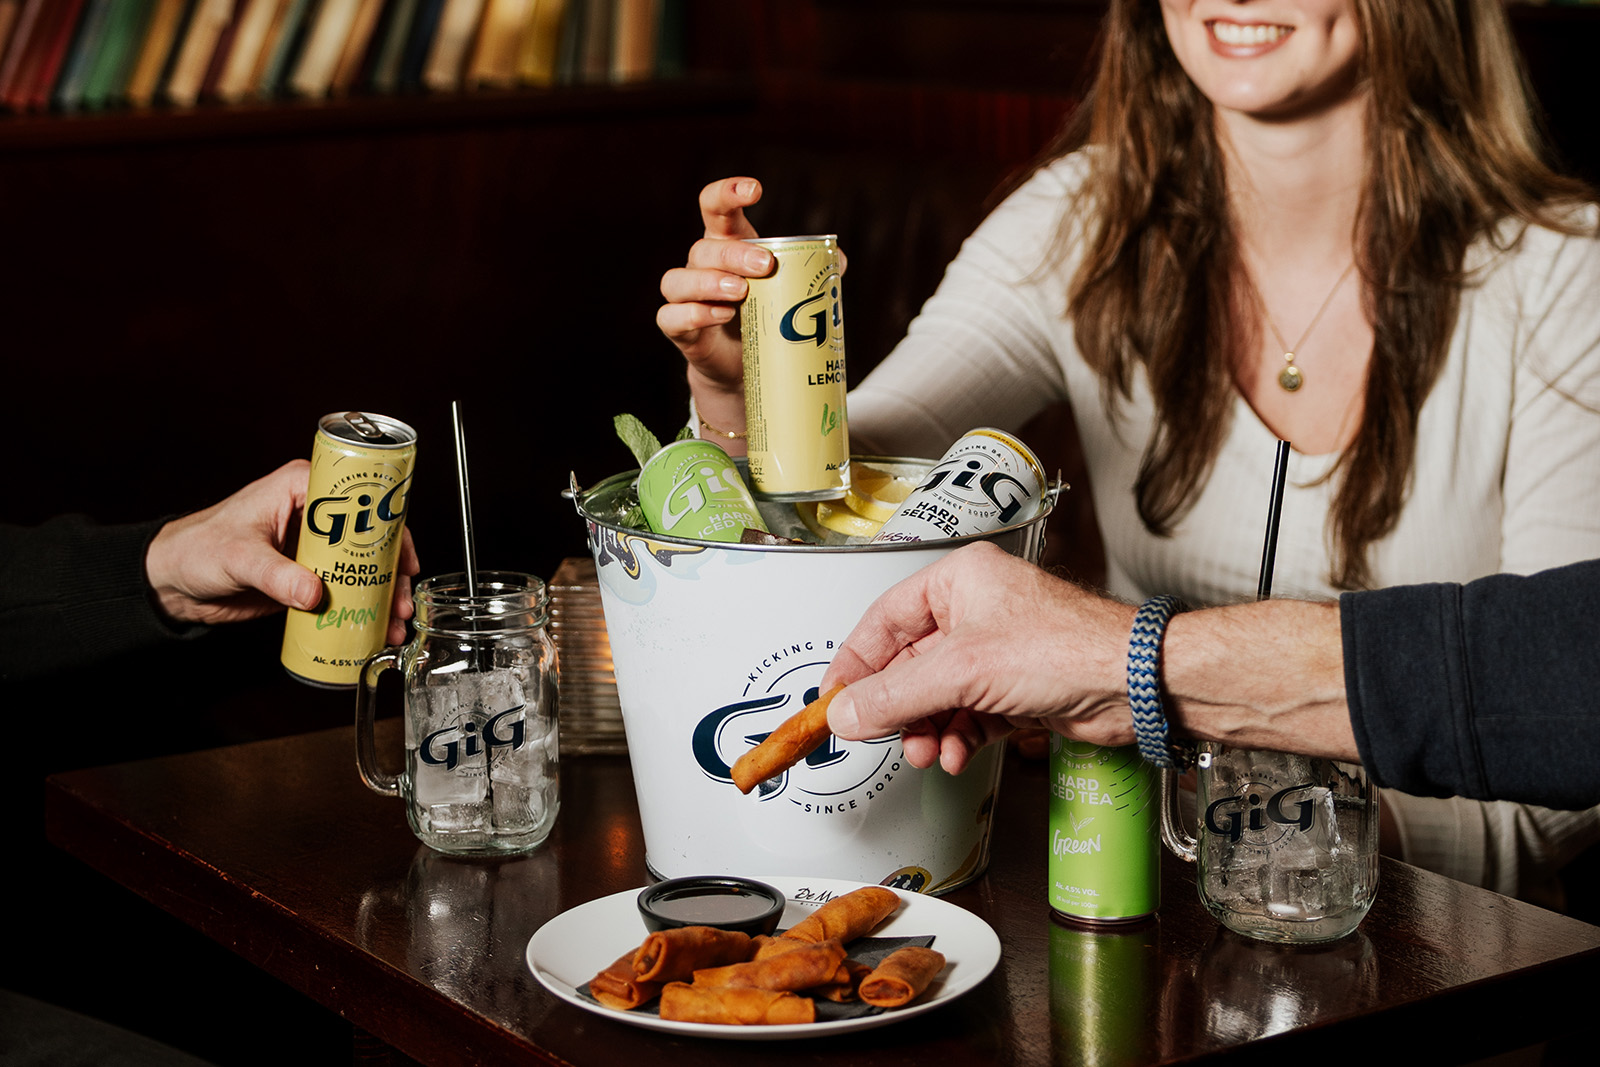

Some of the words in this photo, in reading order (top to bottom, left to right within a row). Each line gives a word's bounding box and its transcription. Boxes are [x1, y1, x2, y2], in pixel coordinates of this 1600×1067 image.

[779, 286, 842, 348] Gi
[826, 359, 845, 371] HAR
[708, 511, 754, 524] HARD
[916, 501, 960, 526] HARD
[698, 519, 736, 539] ICED
[350, 550, 376, 558] SINCE
[334, 561, 378, 575] HARD
[747, 640, 814, 683] KICKING
[419, 704, 527, 772] GiG
[804, 799, 858, 814] SINCE
[866, 761, 901, 800] 2020
[1057, 772, 1099, 791] HARD
[1051, 783, 1076, 801] CED
[1078, 790, 1114, 806] TEA
[1205, 782, 1316, 843] GiG
